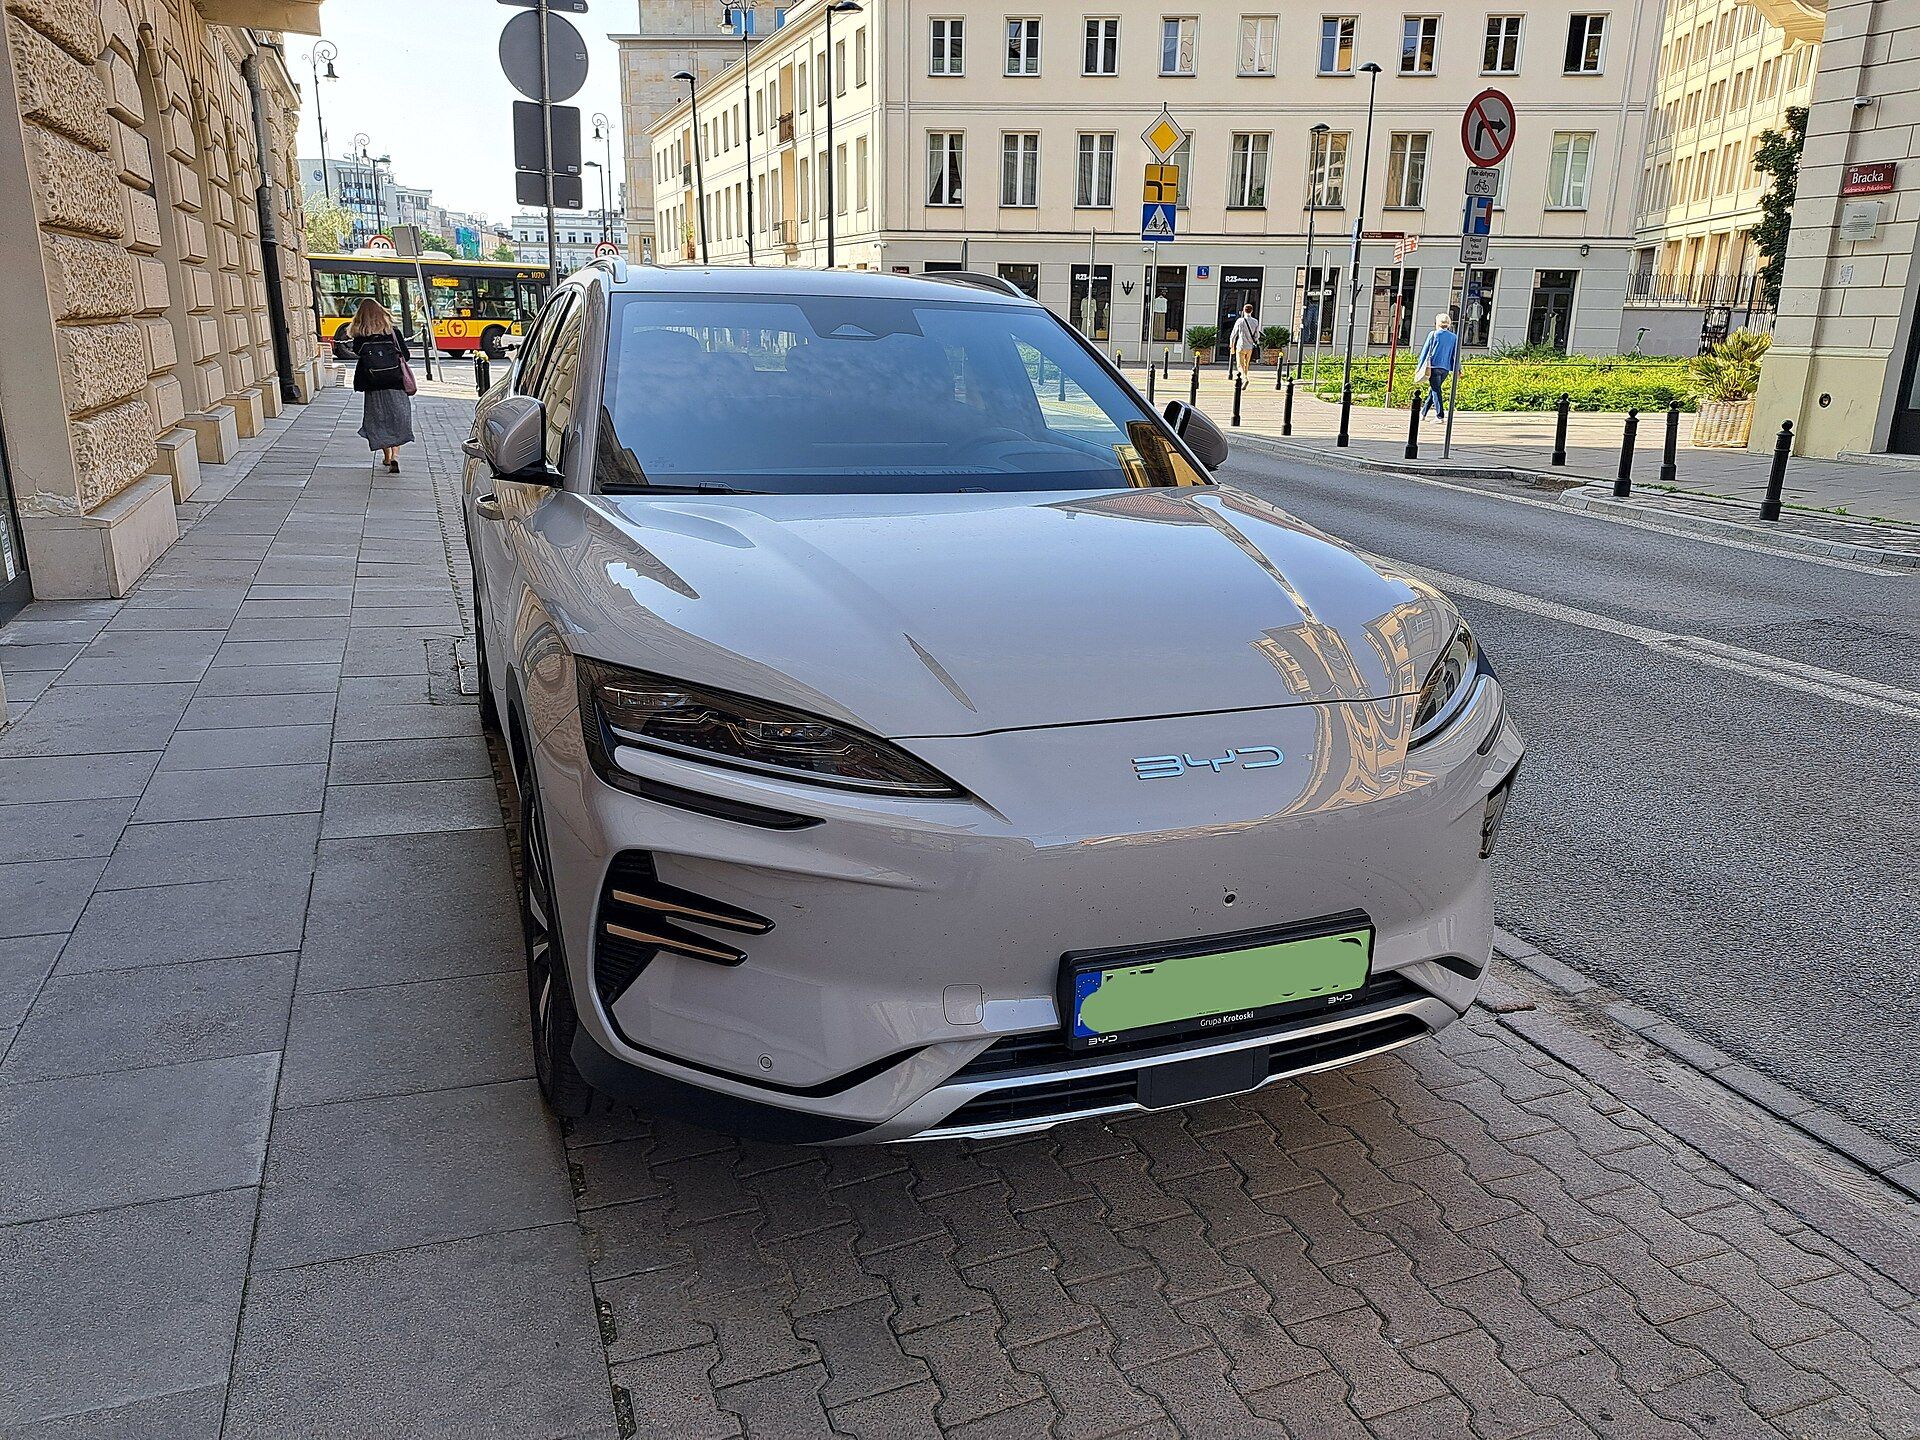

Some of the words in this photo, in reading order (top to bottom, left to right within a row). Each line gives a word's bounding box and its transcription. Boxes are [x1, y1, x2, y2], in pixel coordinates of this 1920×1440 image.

[1852, 169, 1884, 184] Bracka
[1131, 744, 1285, 781] BYD
[1327, 993, 1353, 1005] BYD
[1200, 1018, 1222, 1027] Grupa
[1222, 1010, 1254, 1023] Krotoski
[1088, 1034, 1118, 1046] BYD
